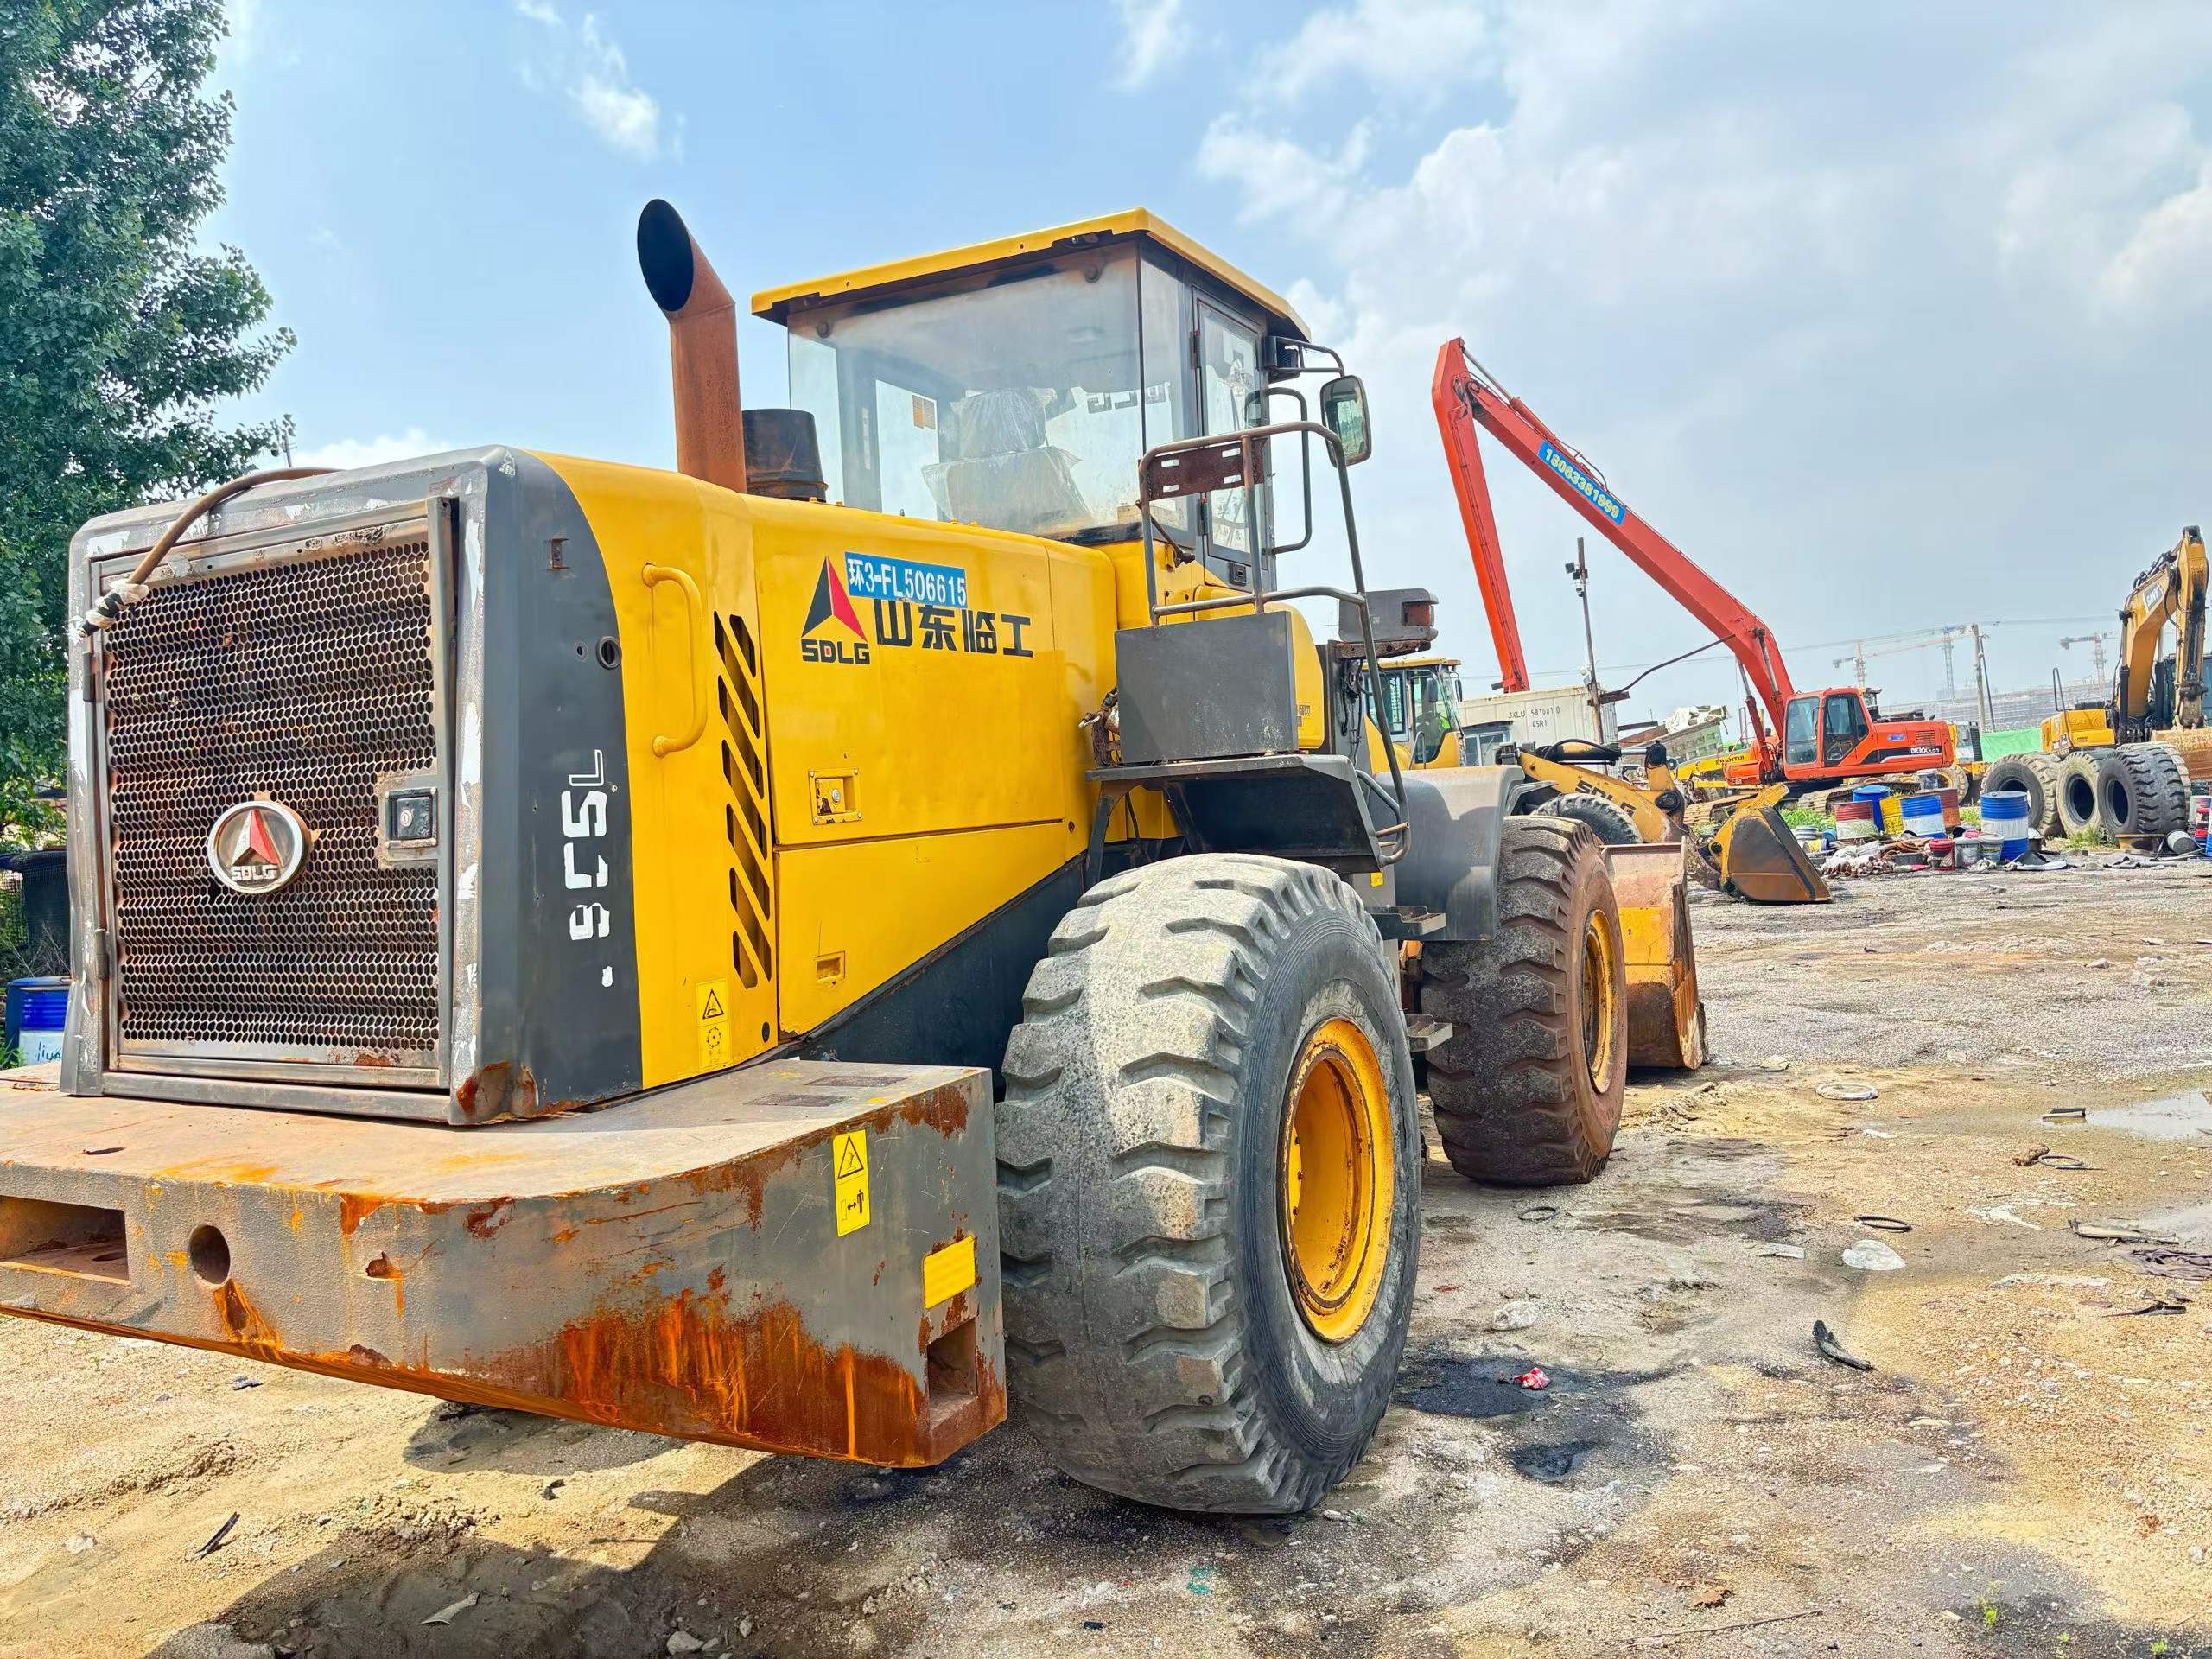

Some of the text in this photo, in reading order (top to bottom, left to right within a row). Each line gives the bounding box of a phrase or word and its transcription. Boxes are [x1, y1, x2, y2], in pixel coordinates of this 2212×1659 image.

[847, 558, 967, 606] 环3-FL506615
[874, 597, 1033, 658] 山东临工
[801, 639, 870, 664] SDLG
[1575, 779, 1637, 817] SDG
[231, 865, 277, 880] SDLG
